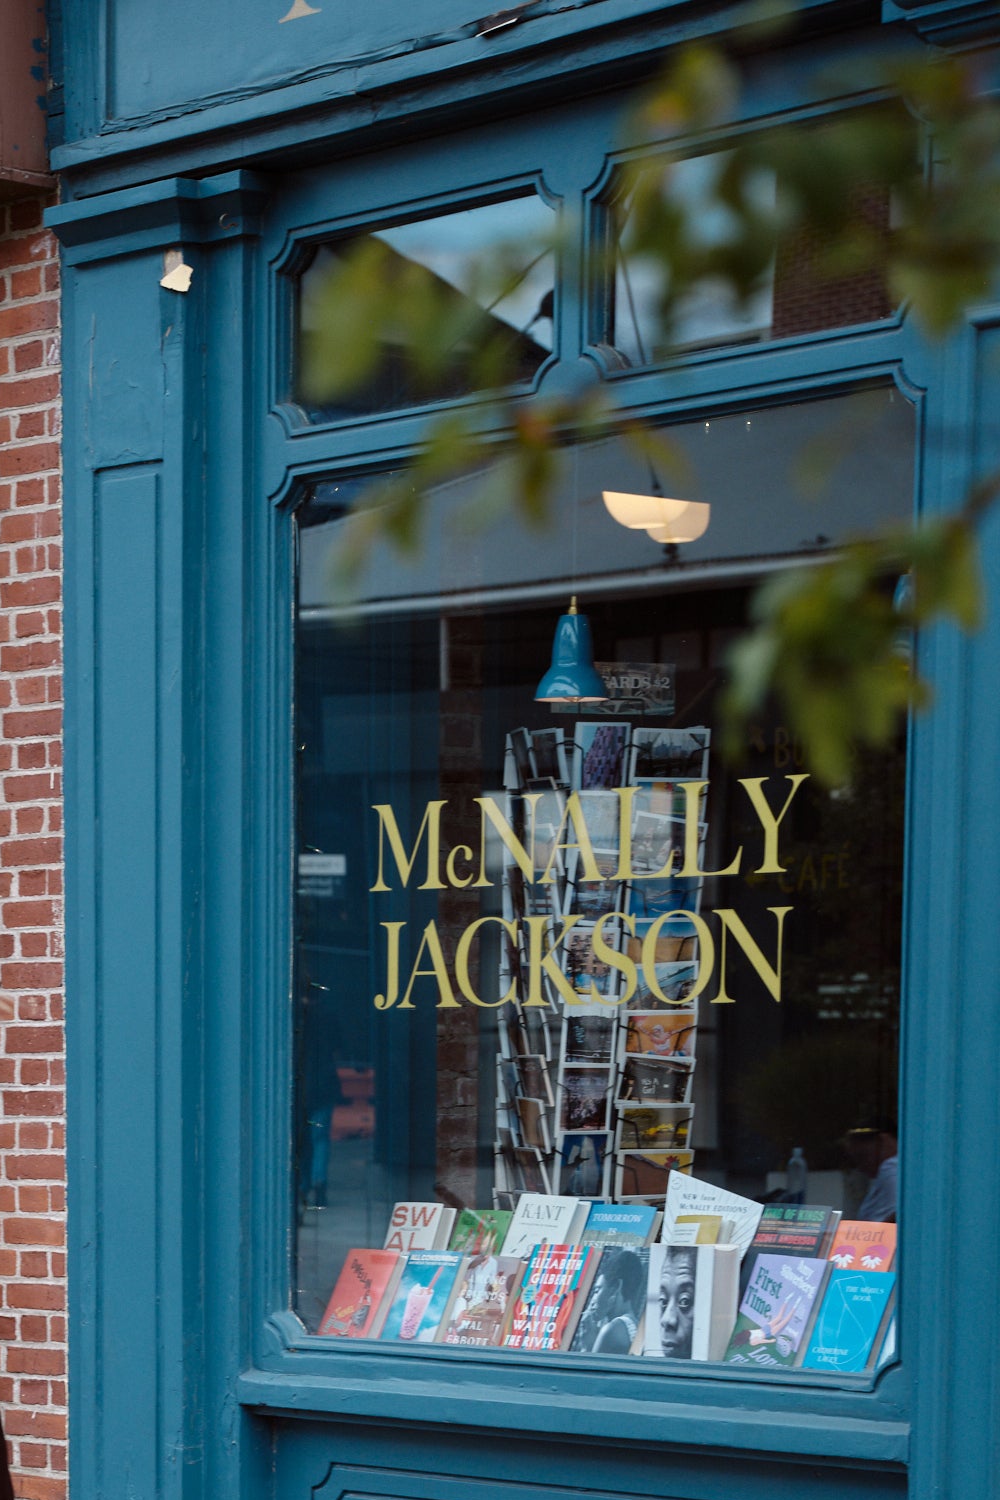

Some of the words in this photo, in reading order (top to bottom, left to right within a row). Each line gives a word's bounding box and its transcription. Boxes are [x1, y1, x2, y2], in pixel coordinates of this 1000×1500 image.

[369, 774, 810, 892] McNALLY
[374, 905, 794, 1010] JACKSON
[682, 1193, 697, 1201] NEW
[391, 1205, 437, 1228] SW
[521, 1203, 566, 1221] KANT
[712, 1205, 748, 1214] EDITIONS
[592, 1213, 643, 1223] TOMORROW
[384, 1231, 425, 1252] AL
[844, 1225, 885, 1243] Heart
[530, 1257, 584, 1271] ELIZABETH
[530, 1273, 573, 1286] GILBERT
[755, 1266, 783, 1300] First
[519, 1305, 541, 1317] ALL
[541, 1306, 561, 1318] THE
[513, 1319, 541, 1332] WAY
[540, 1320, 557, 1333] TO
[503, 1334, 522, 1347] THE
[747, 1346, 789, 1366] Lon
